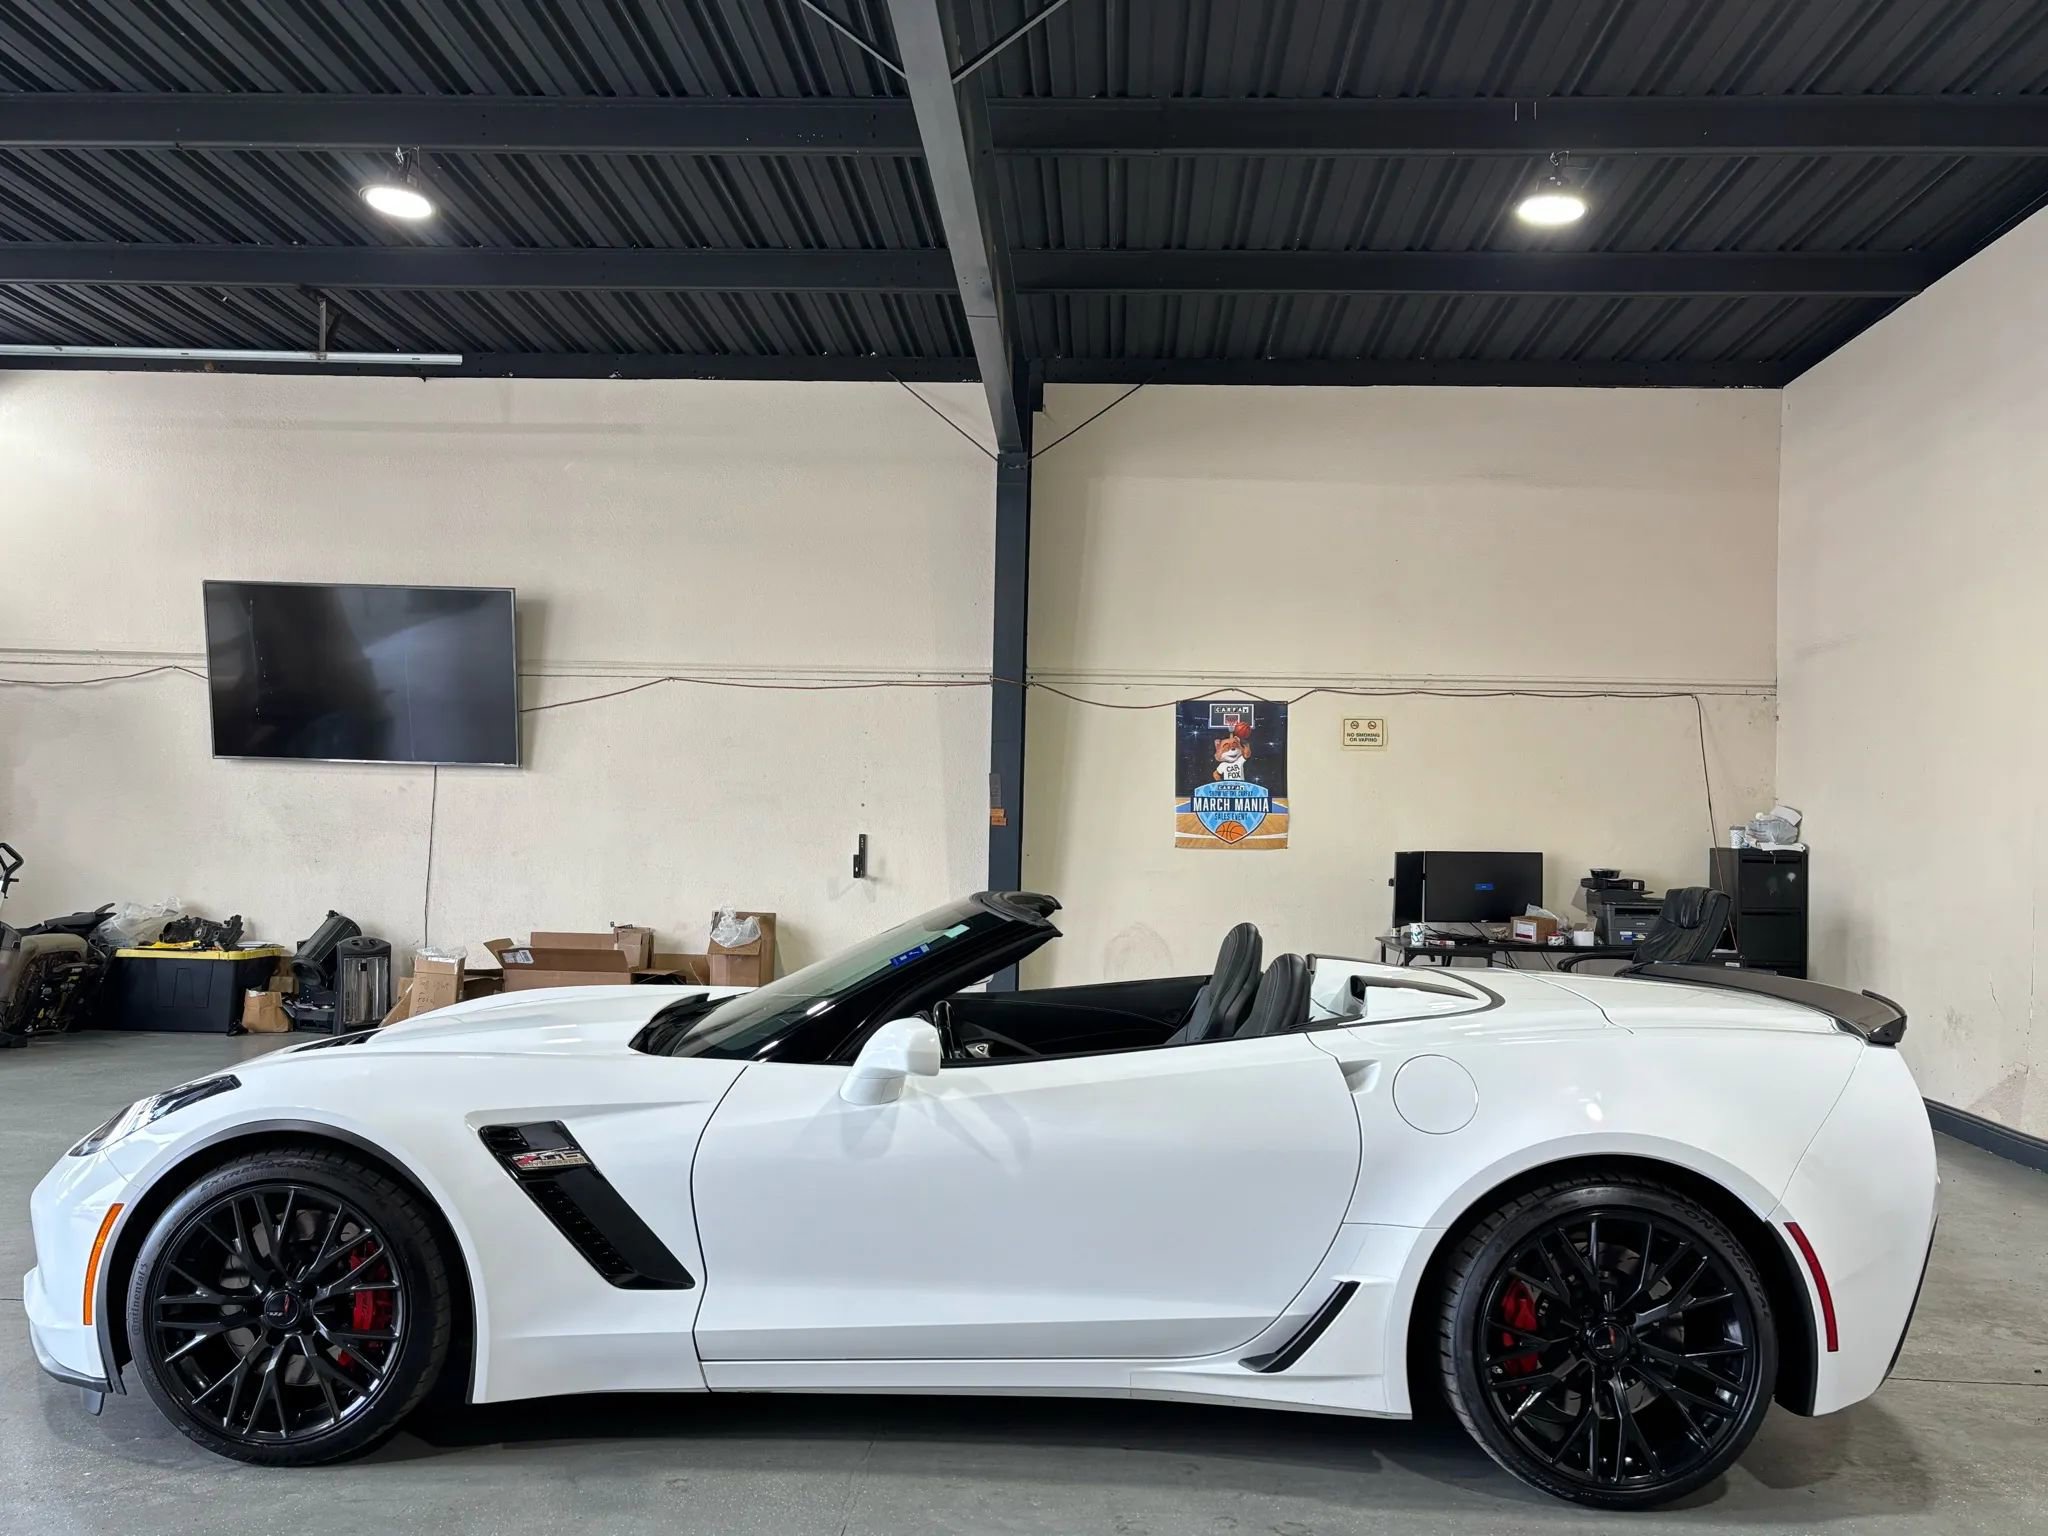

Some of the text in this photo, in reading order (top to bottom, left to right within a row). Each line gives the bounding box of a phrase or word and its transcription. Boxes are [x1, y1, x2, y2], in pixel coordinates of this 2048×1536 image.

[1226, 764, 1240, 773] CAR
[1227, 771, 1241, 779] FOX
[1193, 797, 1270, 813] MARCH MANIA
[1214, 812, 1248, 821] SALES EVENT
